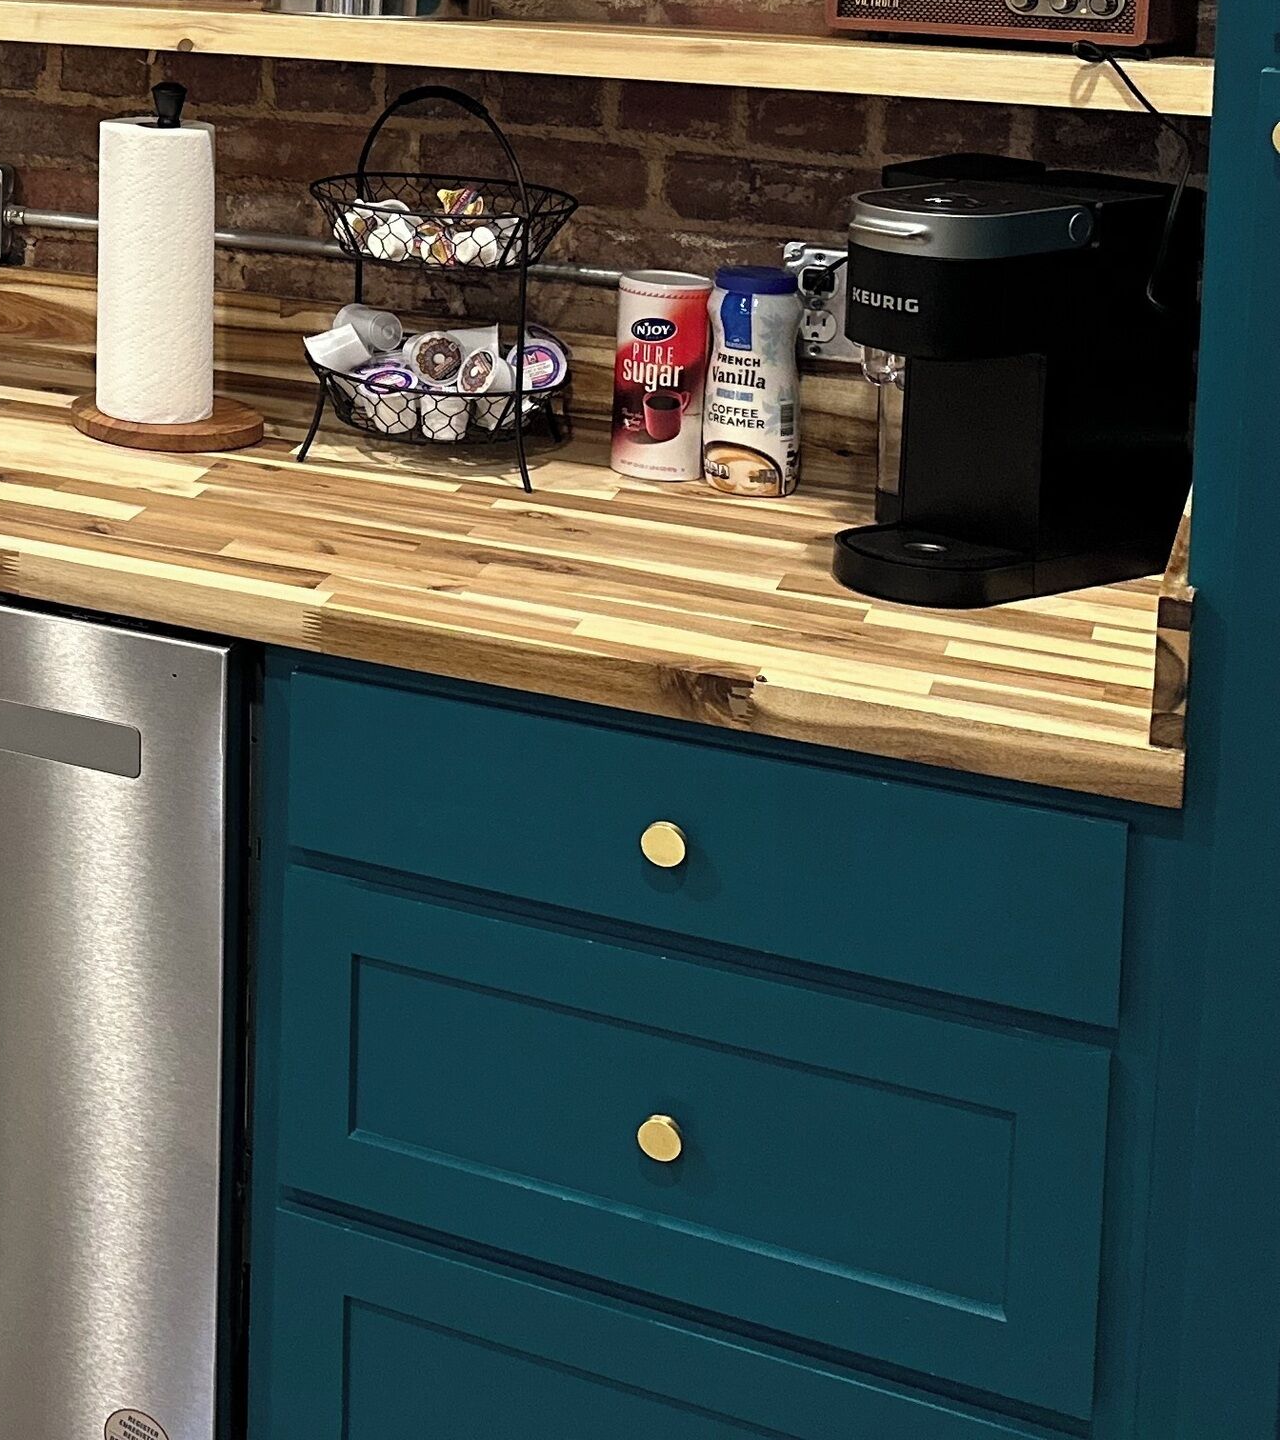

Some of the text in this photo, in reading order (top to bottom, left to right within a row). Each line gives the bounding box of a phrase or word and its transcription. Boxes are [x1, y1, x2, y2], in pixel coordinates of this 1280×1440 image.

[852, 286, 919, 313] KEURIG
[632, 342, 674, 365] PURE
[717, 352, 761, 368] FRENCH
[622, 358, 684, 393] sugar
[712, 366, 767, 390] Vanilla
[708, 411, 766, 430] CREAMER
[711, 403, 759, 419] COFFEE
